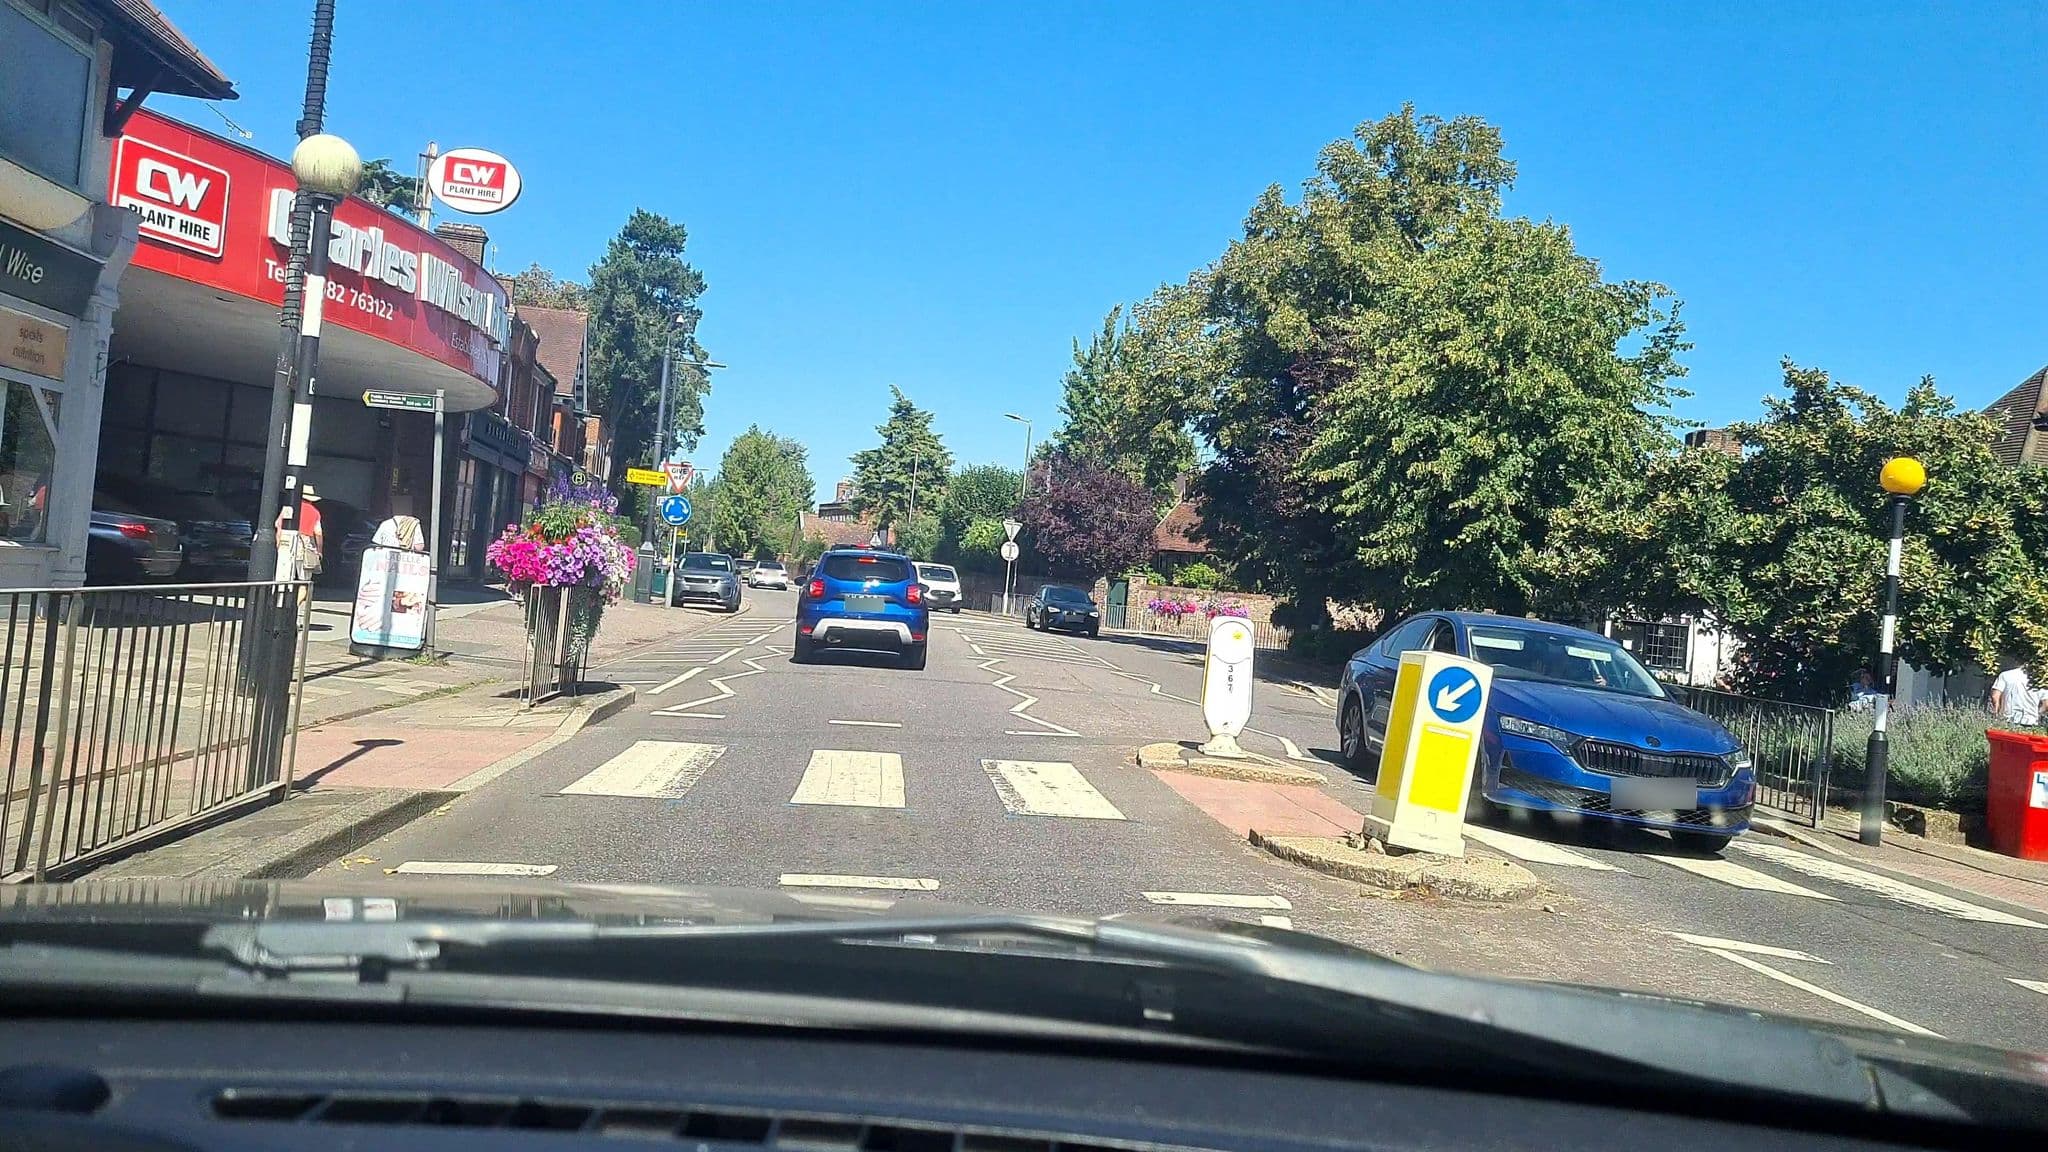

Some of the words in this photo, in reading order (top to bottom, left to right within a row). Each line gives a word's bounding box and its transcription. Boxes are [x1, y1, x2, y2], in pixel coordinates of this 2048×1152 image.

[136, 158, 211, 212] CW
[453, 163, 496, 185] CW
[449, 185, 475, 196] PLANT
[477, 188, 496, 198] HIRE
[180, 219, 210, 241] HIRE
[268, 188, 417, 294] Carles
[7, 247, 44, 284] Wise
[350, 289, 393, 321] 763122
[671, 467, 688, 475] GIVE
